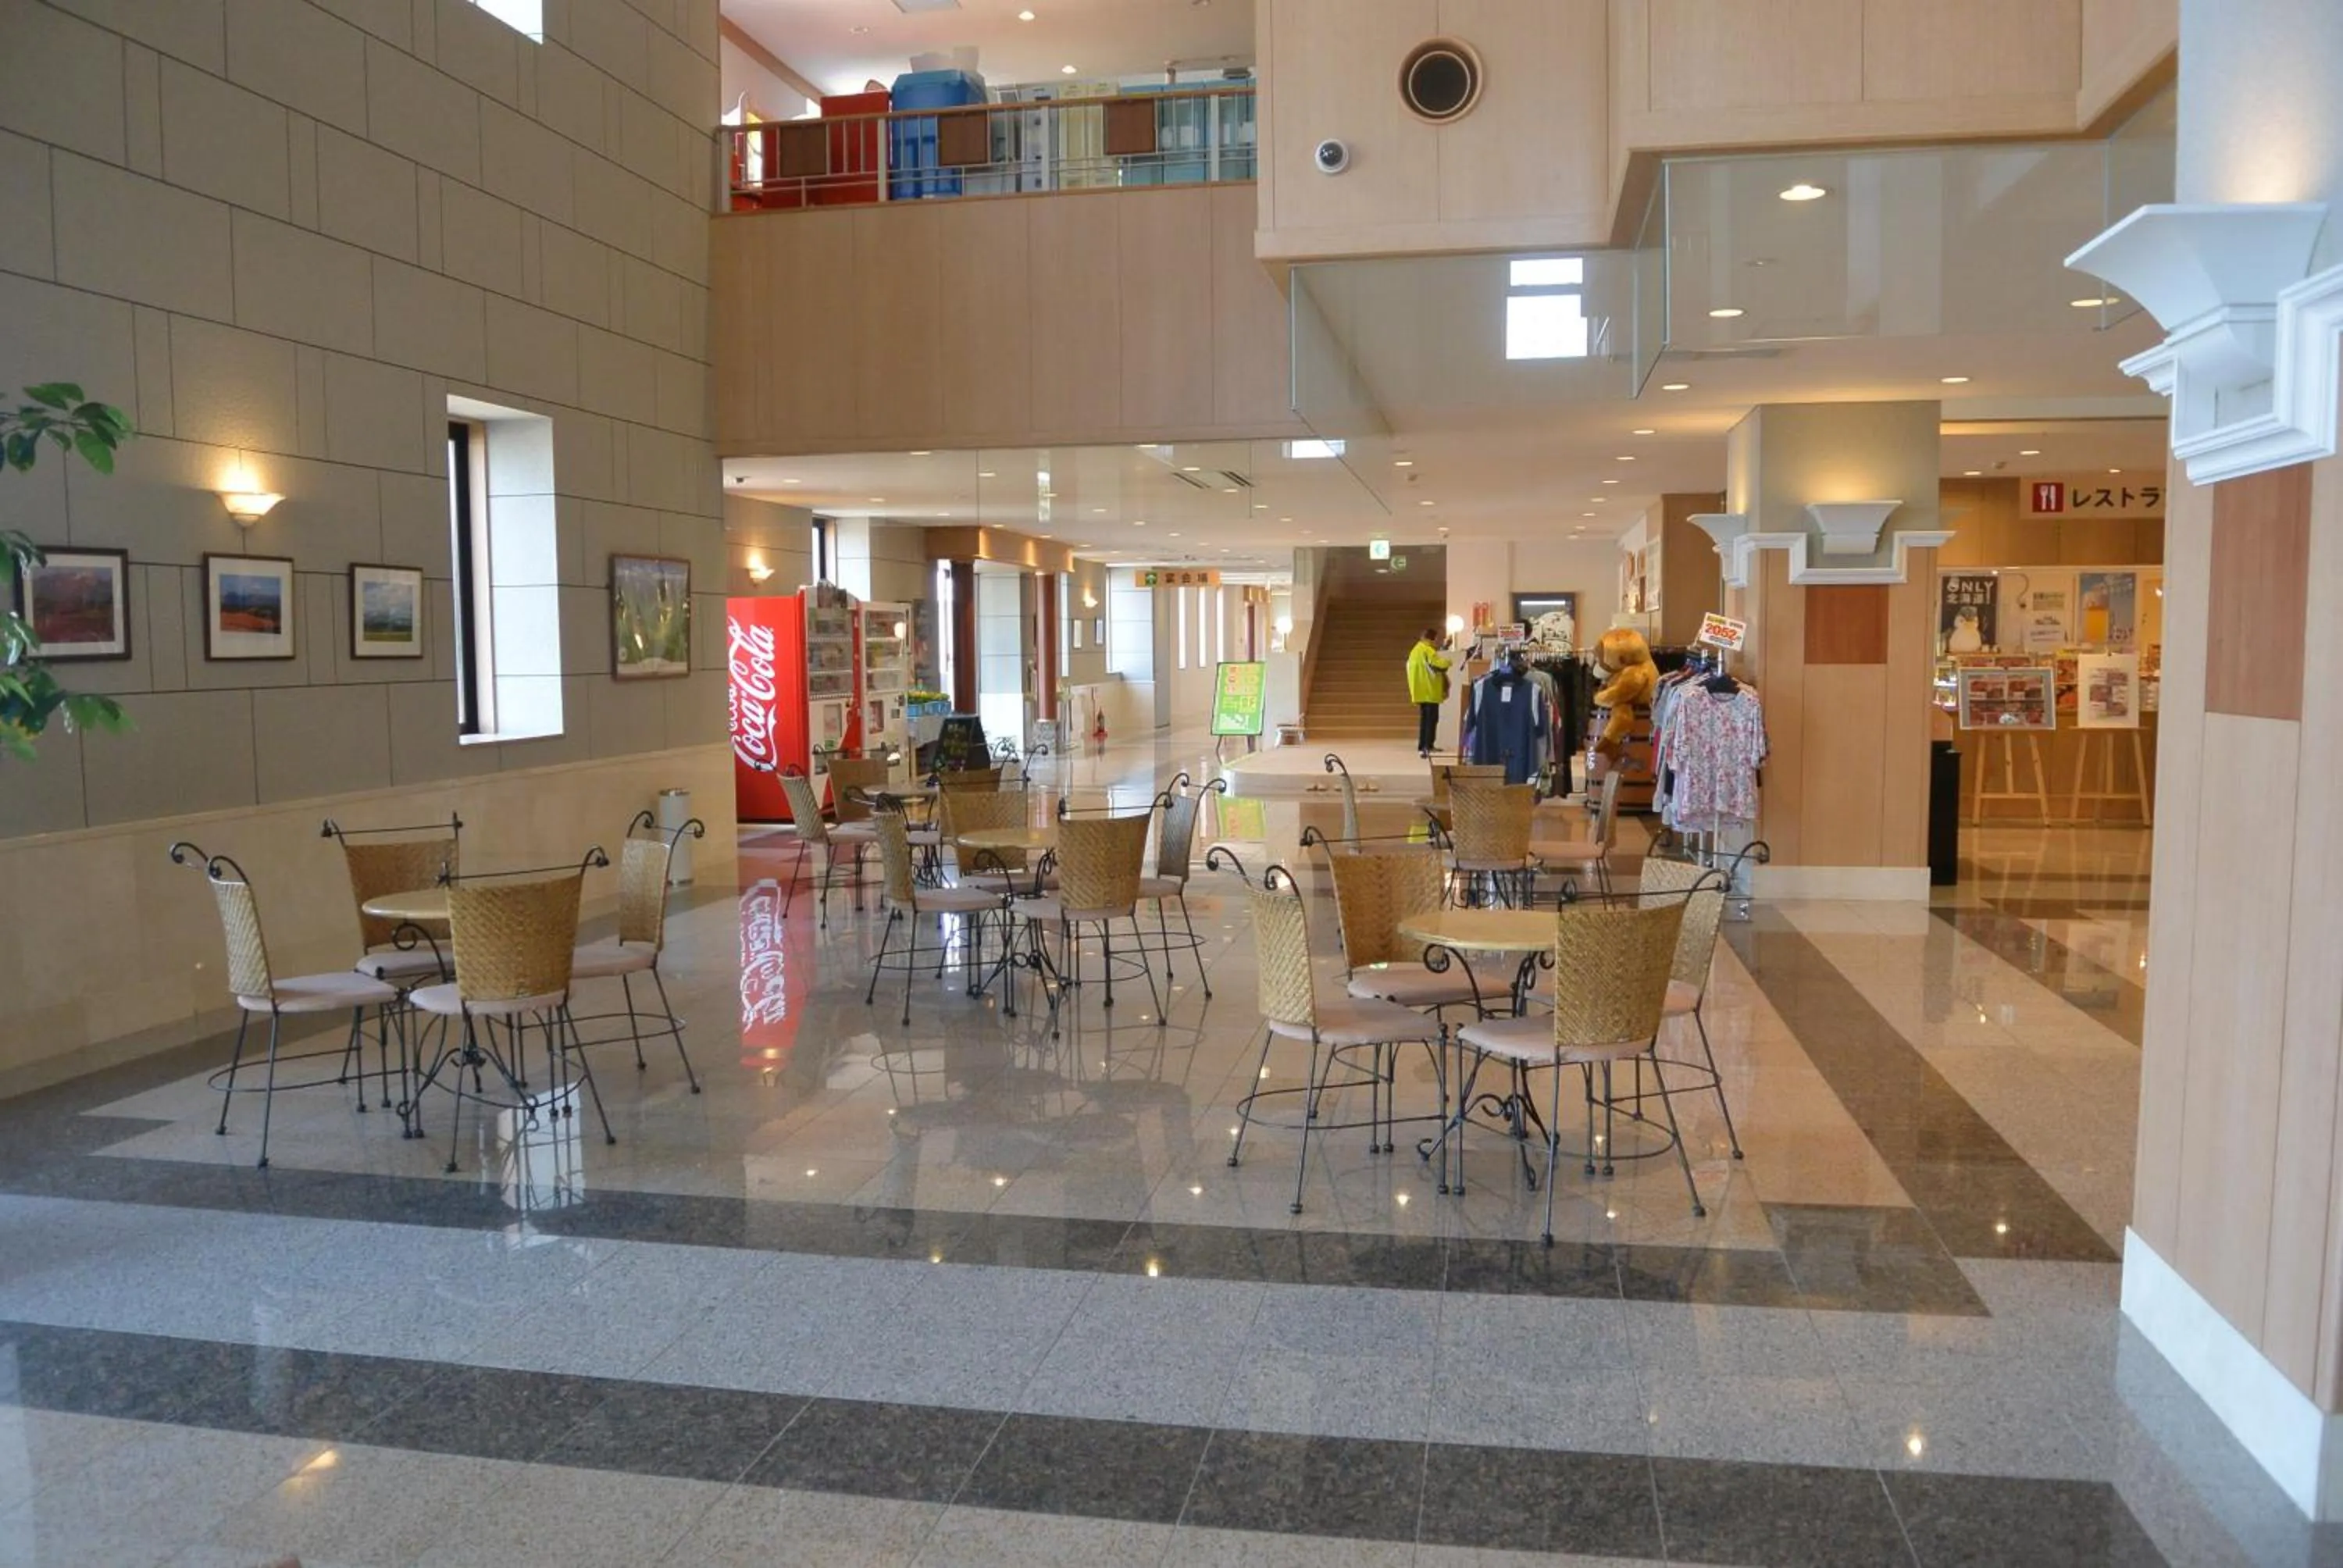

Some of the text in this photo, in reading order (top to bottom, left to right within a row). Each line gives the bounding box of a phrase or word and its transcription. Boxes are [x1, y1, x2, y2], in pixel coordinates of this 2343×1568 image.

[2072, 487, 2165, 508] レストラ
[1946, 579, 1994, 604] ONLY
[729, 615, 776, 772] Coca-Cola
